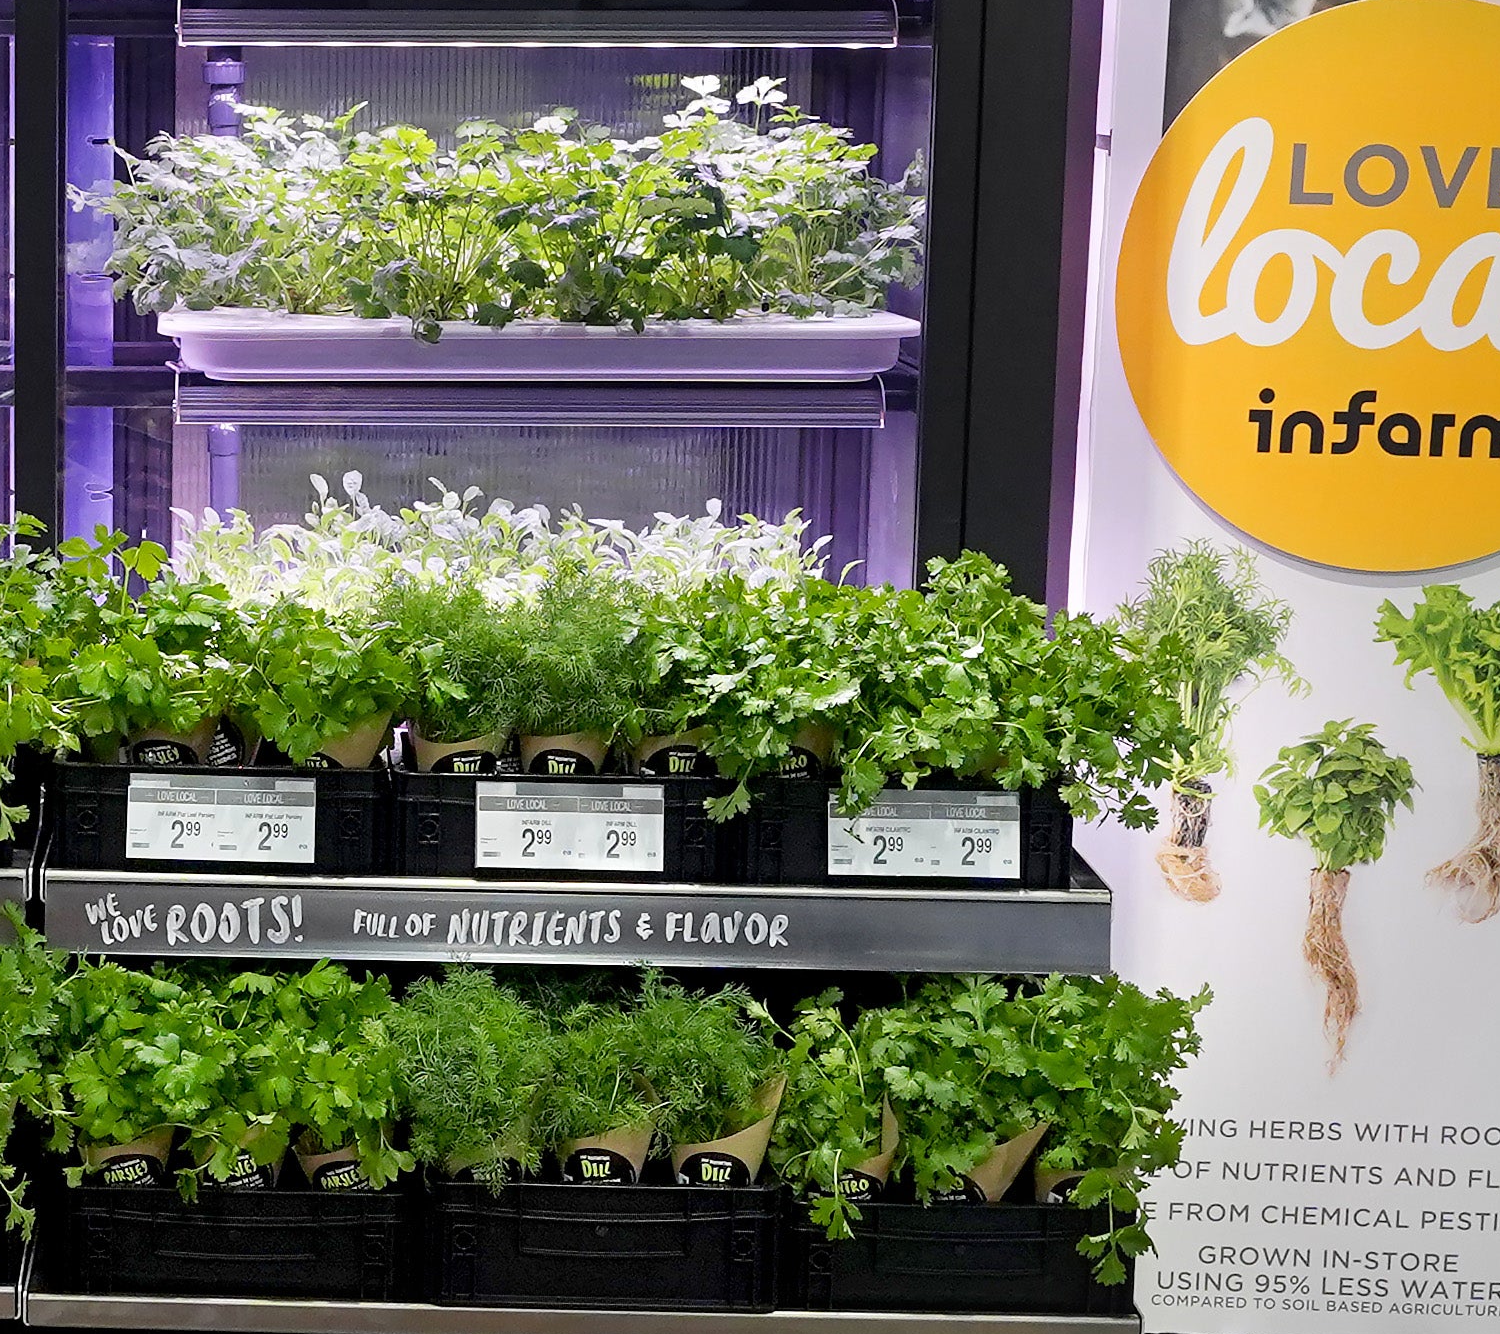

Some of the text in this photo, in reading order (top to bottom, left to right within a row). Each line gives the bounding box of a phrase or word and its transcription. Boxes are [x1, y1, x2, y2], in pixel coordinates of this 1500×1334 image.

[158, 792, 197, 802] LOVE LOCAL
[1250, 1121, 1341, 1140] HERBS
[1355, 1123, 1428, 1143] WITH
[1173, 1160, 1211, 1180] OF
[1223, 1162, 1382, 1184] NUTRIENTS
[1394, 1168, 1455, 1187] AND
[1169, 1203, 1249, 1222] FROM
[1262, 1206, 1409, 1228] CHEMICAL
[1199, 1246, 1458, 1272] GROWN IN-STORE
[1158, 1271, 1242, 1292] USING
[1256, 1275, 1309, 1294] 95%
[1322, 1277, 1388, 1297] LESS
[1152, 1294, 1247, 1308] COMPARED
[1253, 1298, 1275, 1309] TO
[1282, 1299, 1319, 1311] SOIL
[1327, 1301, 1382, 1313] BASED
